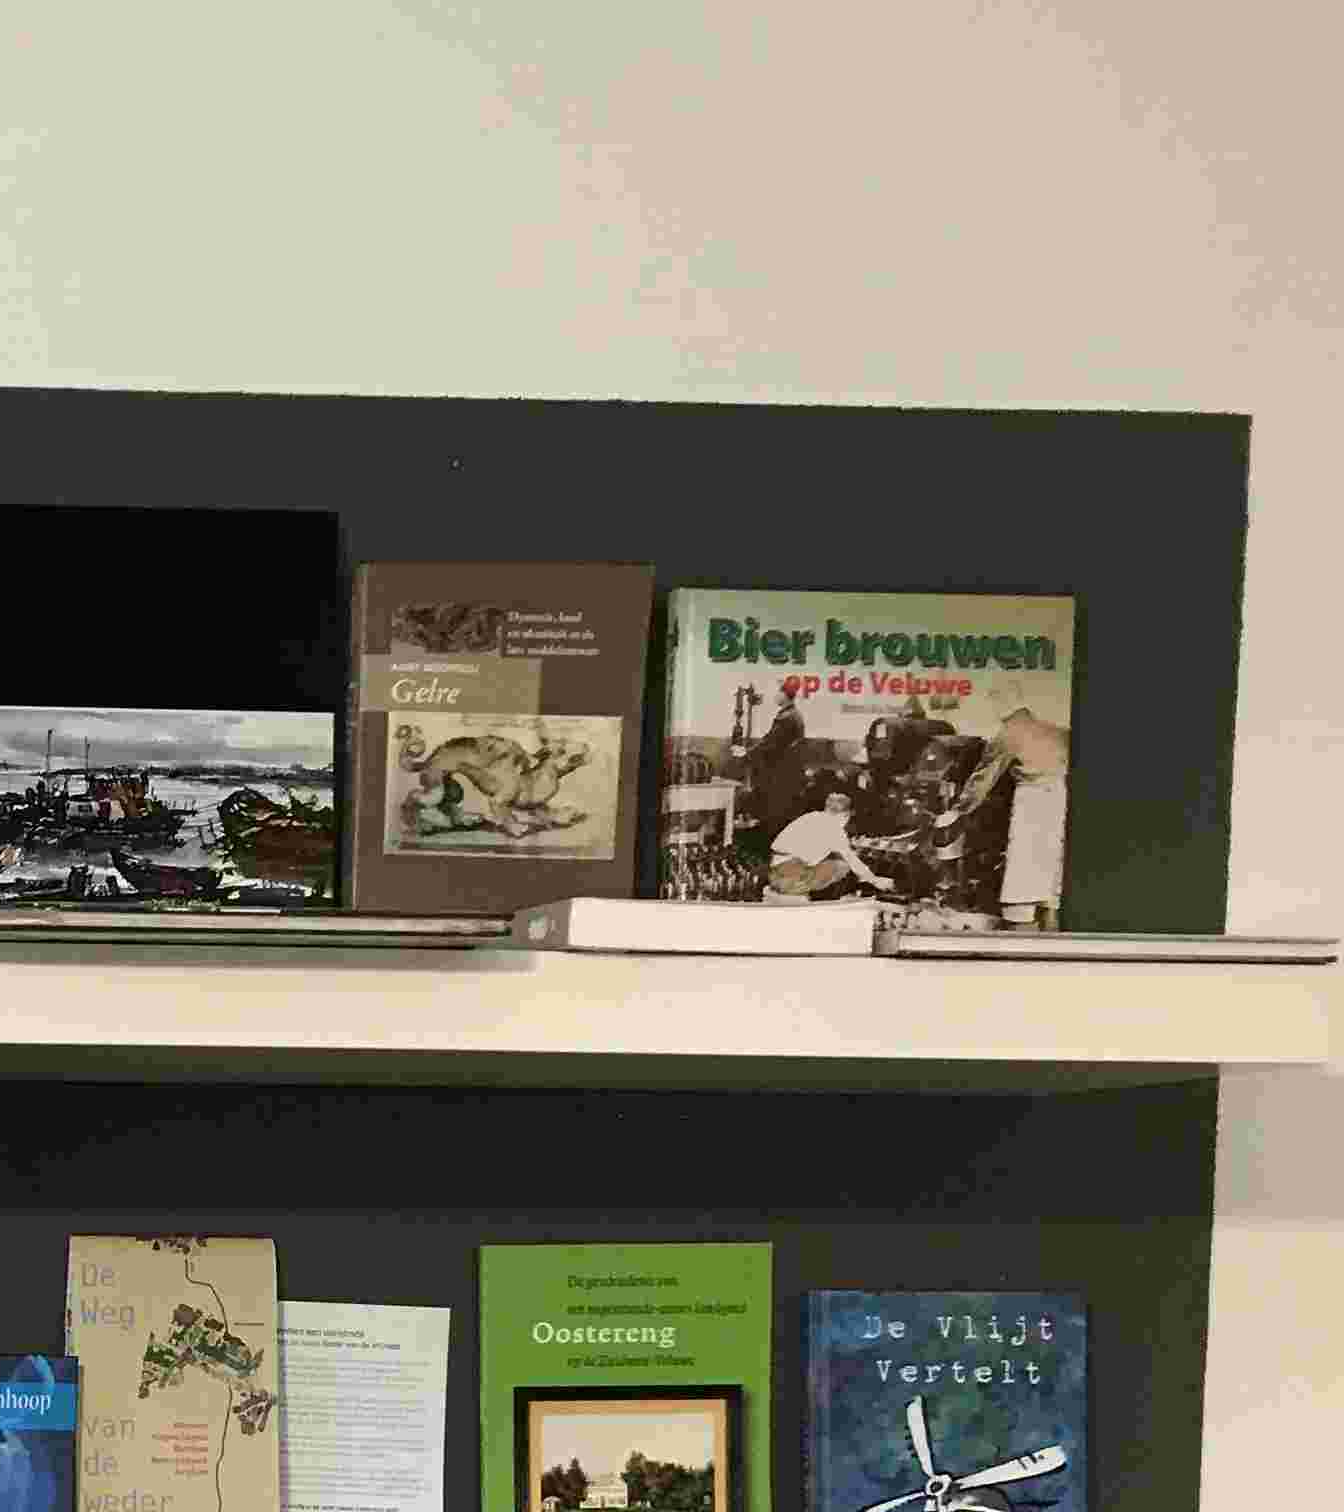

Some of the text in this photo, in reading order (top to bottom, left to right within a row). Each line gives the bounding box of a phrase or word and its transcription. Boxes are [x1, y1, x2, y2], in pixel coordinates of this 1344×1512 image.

[708, 617, 1056, 670] Bier brouwen
[391, 678, 462, 704] Gelre
[784, 672, 973, 699] op de Veluwe
[532, 1322, 677, 1348] Oostereng
[863, 1316, 1056, 1346] De Vlijt
[876, 1360, 1042, 1383] Vertelt
